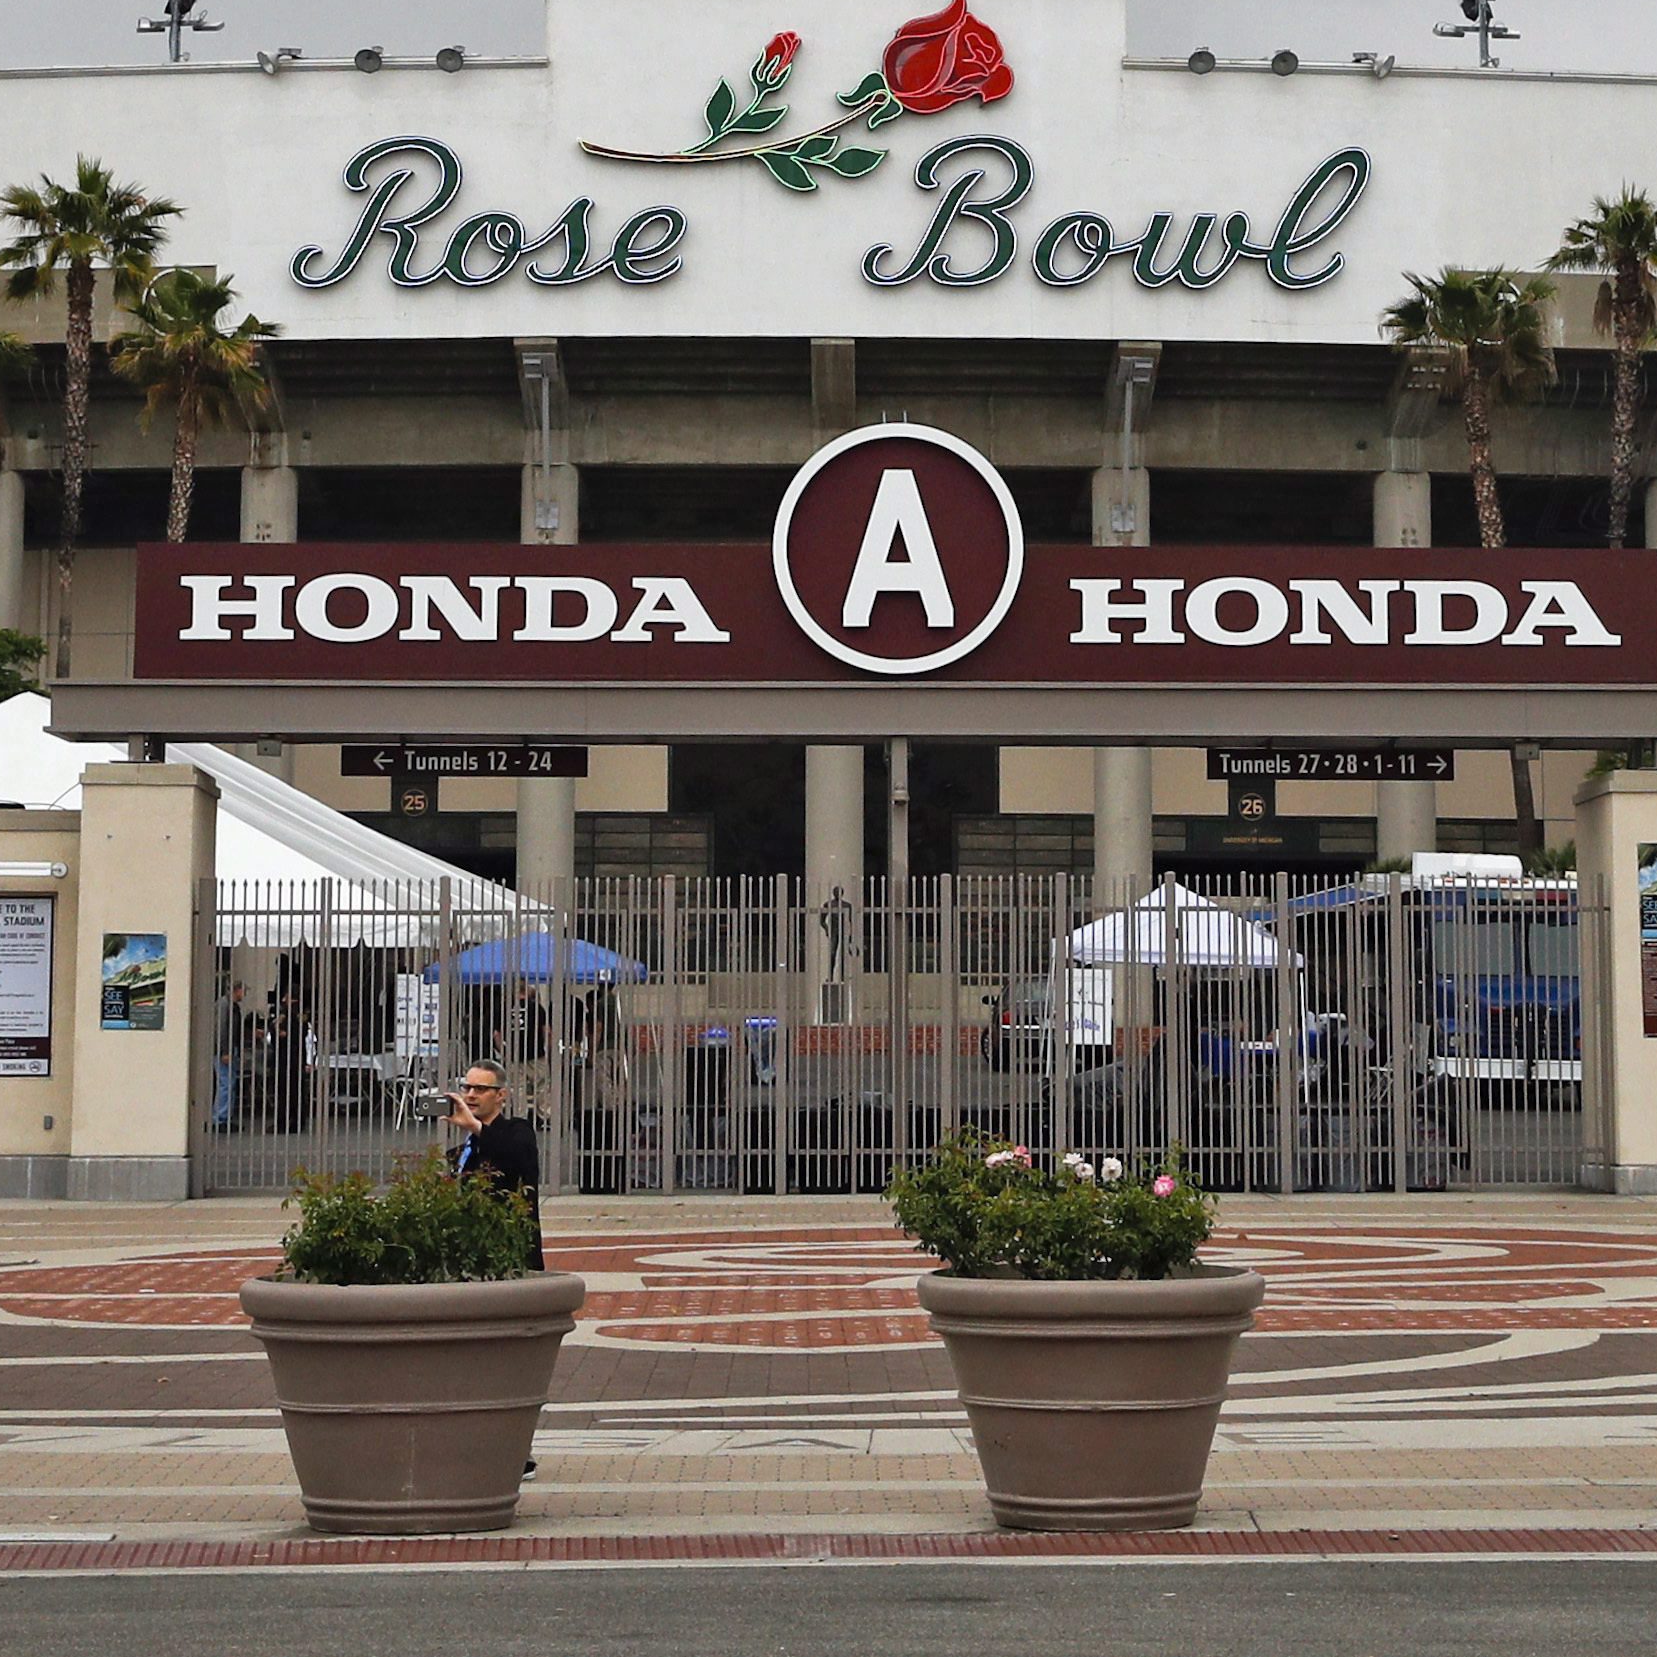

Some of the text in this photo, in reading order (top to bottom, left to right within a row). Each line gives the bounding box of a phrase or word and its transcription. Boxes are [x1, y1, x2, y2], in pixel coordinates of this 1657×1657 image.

[291, 135, 1371, 289] Rose Bowl
[844, 468, 955, 629] A
[178, 574, 731, 643] HONDA
[1068, 578, 1621, 647] HONDA
[405, 750, 479, 772] Tunnels
[487, 751, 508, 772] 12
[528, 751, 553, 772] 24
[1219, 753, 1291, 774] Tunnels
[404, 795, 425, 811] 25
[1241, 799, 1264, 816] 26
[6, 904, 17, 914] TO
[20, 904, 35, 914] THE
[4, 916, 45, 927] STADIUM
[104, 991, 123, 1001] SEE
[104, 1005, 125, 1014] SAY
